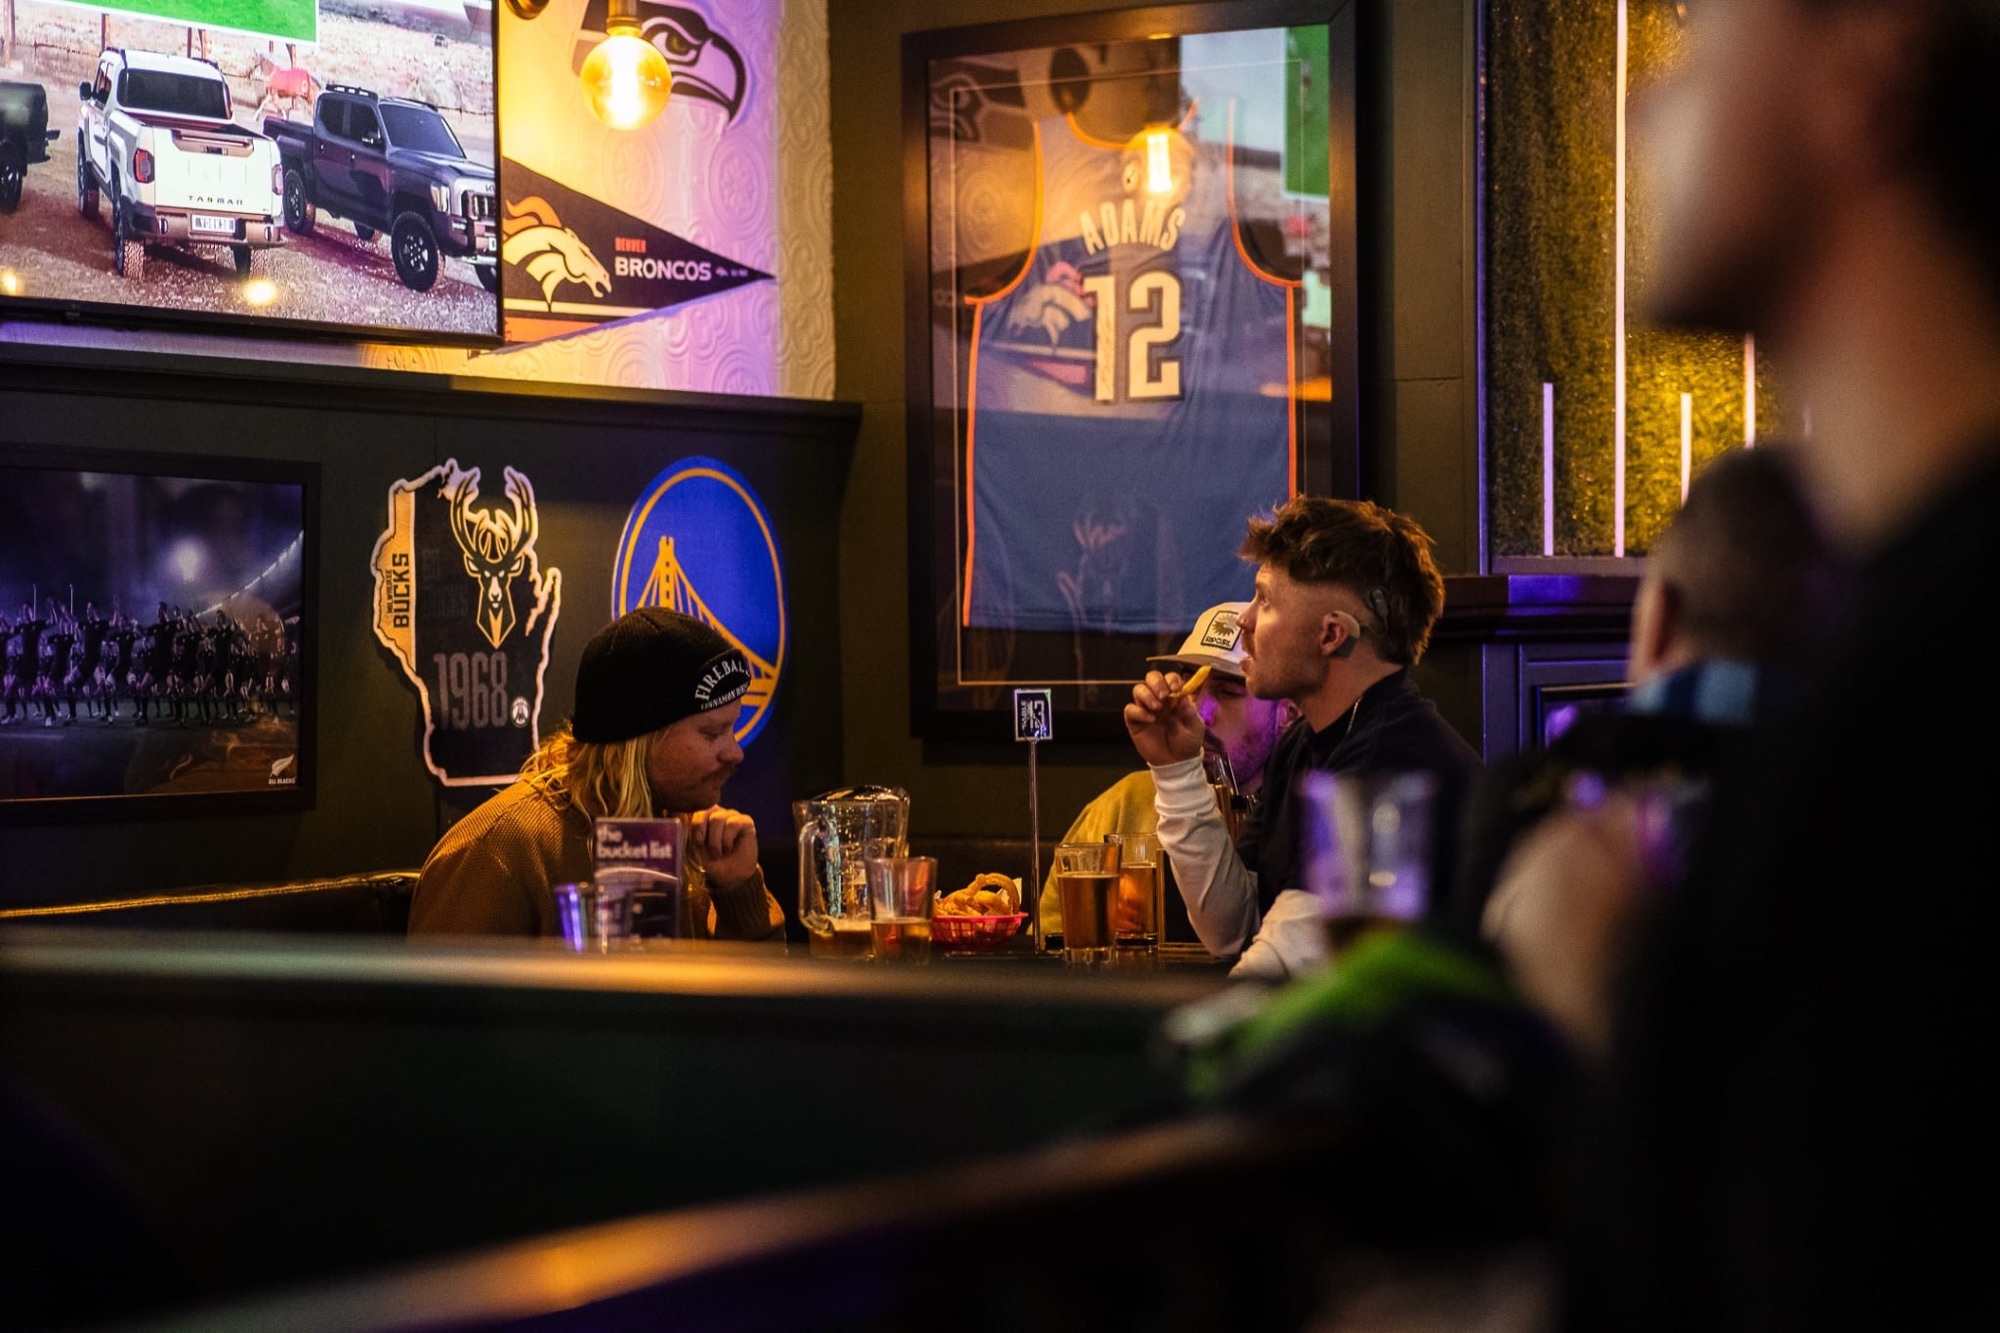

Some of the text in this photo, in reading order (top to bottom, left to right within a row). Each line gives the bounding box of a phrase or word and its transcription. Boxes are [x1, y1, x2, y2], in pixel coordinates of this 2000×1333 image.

[1079, 199, 1186, 256] ADAMS
[615, 256, 712, 281] BRONCOS
[1084, 271, 1181, 399] 12
[392, 553, 410, 629] BUCKS
[433, 651, 508, 731] 1968
